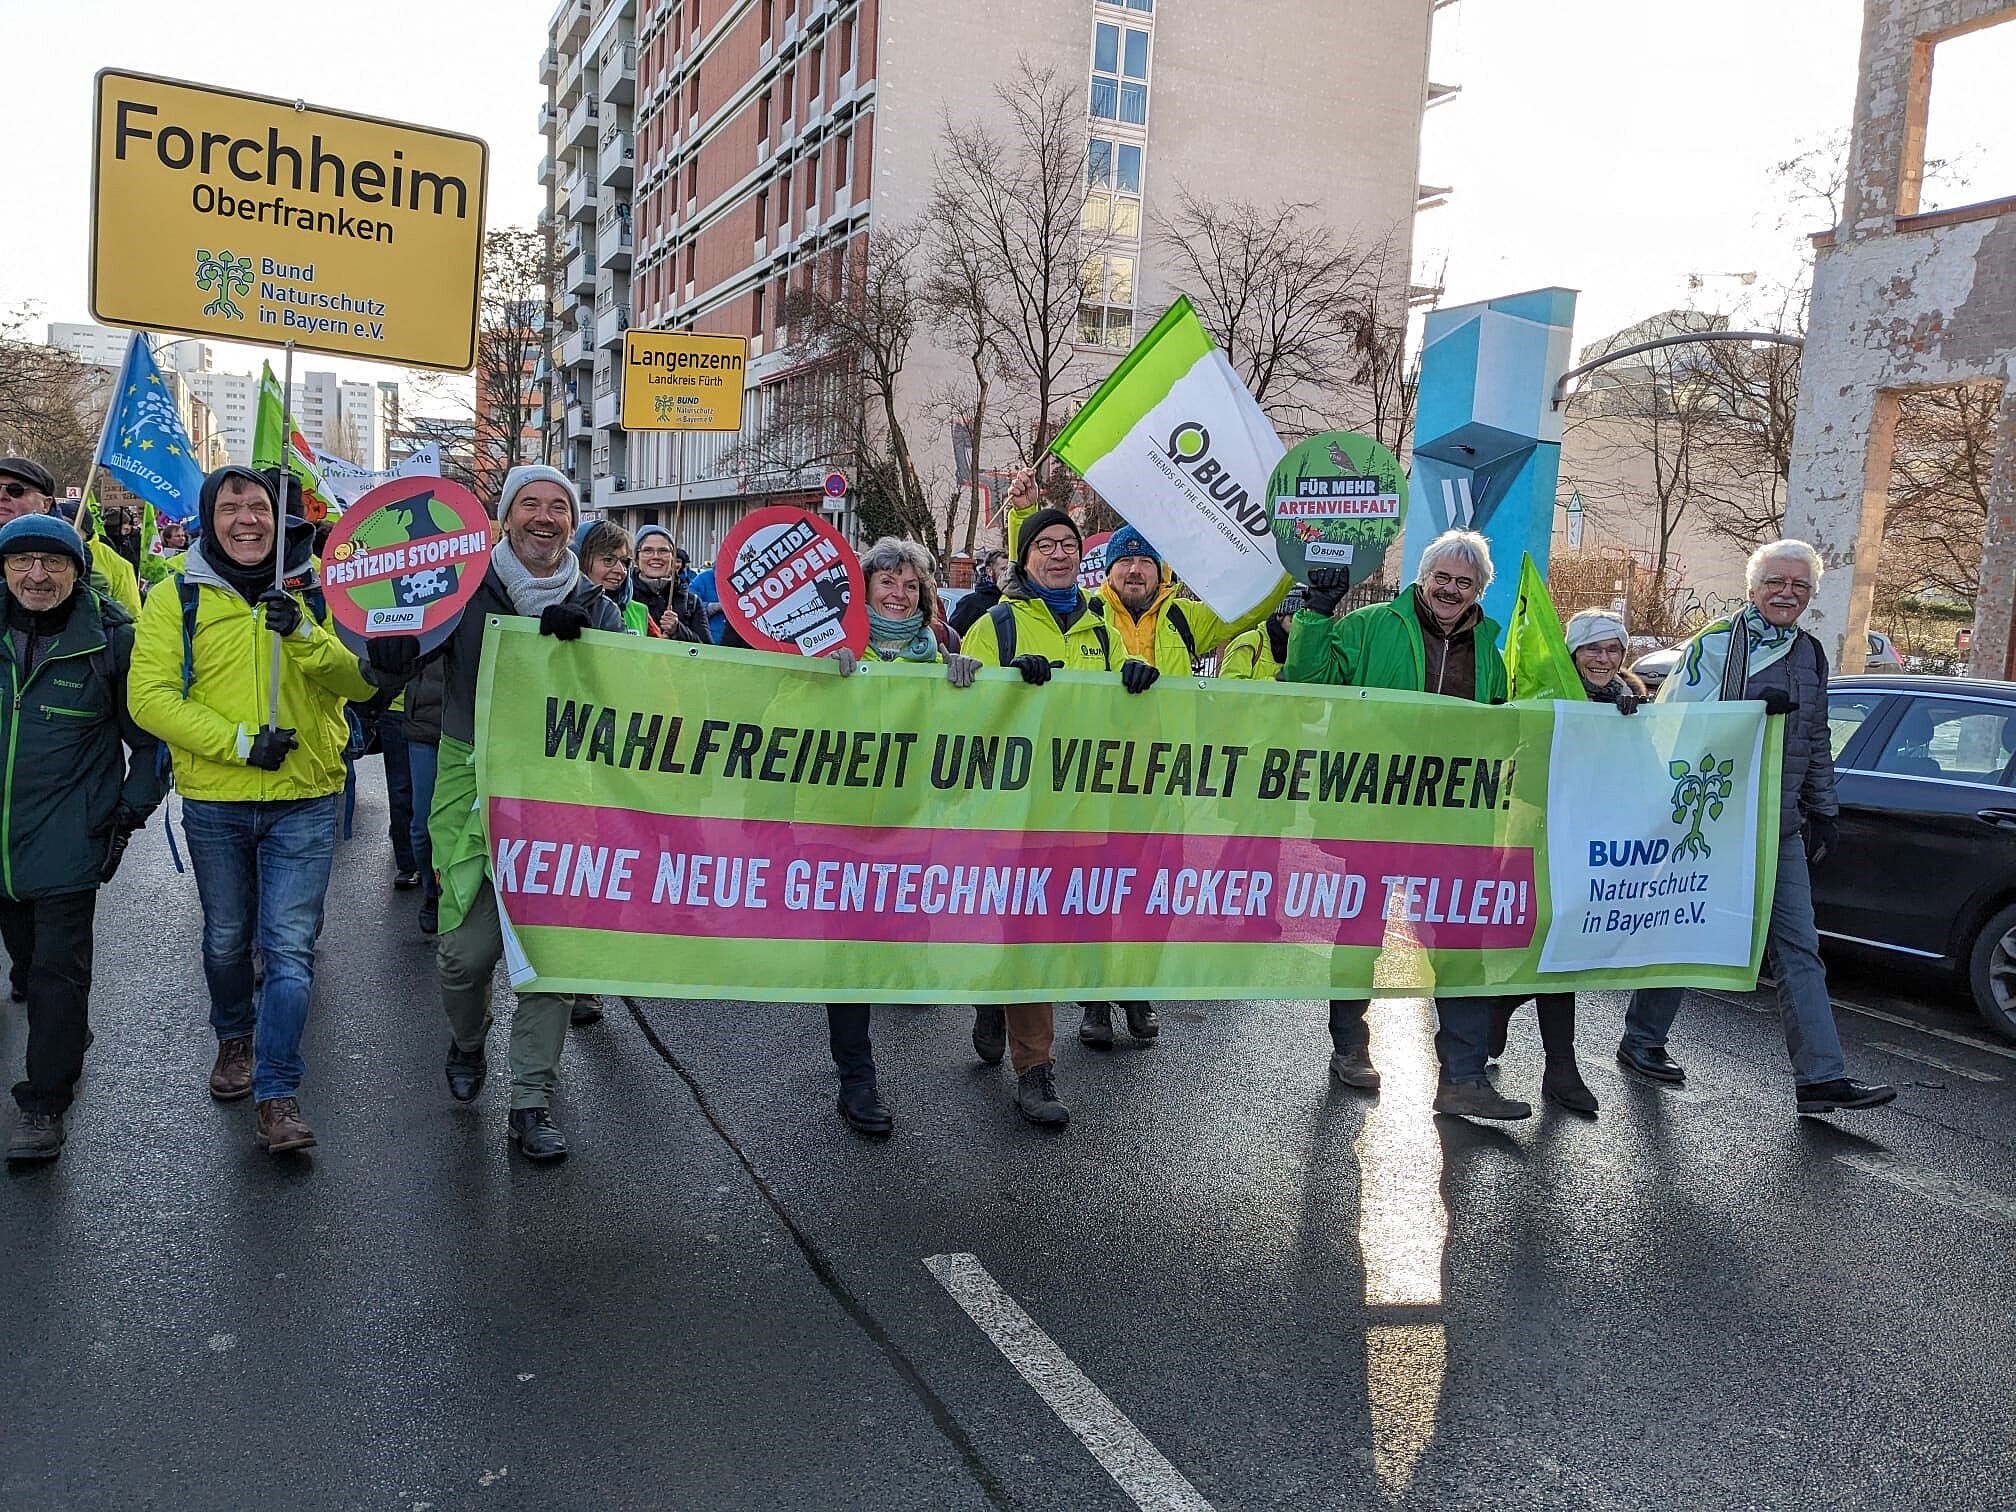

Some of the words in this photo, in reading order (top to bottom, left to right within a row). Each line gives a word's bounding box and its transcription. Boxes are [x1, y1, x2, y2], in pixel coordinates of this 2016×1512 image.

[115, 99, 467, 218] Forchheim
[192, 184, 393, 243] Oberfranken
[262, 258, 313, 281] Bund
[261, 283, 385, 316] Naturschutz
[260, 305, 276, 323] in
[284, 310, 347, 334] Bayern
[354, 322, 384, 339] e.V.
[630, 344, 741, 372] Langenzenn
[649, 373, 695, 386] Landkreis
[699, 376, 722, 386] Fürth
[1192, 457, 1271, 536] BUND
[1300, 478, 1328, 495] FÜR
[1332, 480, 1376, 494] MEHR
[1148, 450, 1176, 480] FRIENDS
[1174, 478, 1185, 490] OF
[1184, 488, 1199, 504] THE
[1196, 501, 1219, 524] EARTH
[1216, 522, 1250, 556] GERMANY
[1277, 500, 1397, 515] ARTENVIELFALT
[326, 549, 405, 586] PESTIZIDE
[408, 531, 487, 567] STOPPEN!
[731, 522, 814, 593] PESTIZIDE
[1080, 556, 1106, 573] PEST
[1320, 548, 1345, 557] BUND
[738, 538, 839, 618] STOPPEN
[1077, 571, 1107, 587] STO
[385, 613, 414, 623] BUND
[813, 628, 835, 644] BUND
[544, 697, 918, 788] WAHLFREIHEIT
[930, 734, 1033, 792] UND
[1051, 737, 1249, 798] VIELFALT
[1257, 748, 1516, 811] BEWAHREN!
[1589, 838, 1670, 867] BUND
[497, 838, 641, 902] KEINE
[651, 852, 770, 908] NEUE
[785, 860, 1053, 916] GENTECHNIK
[1061, 867, 1137, 917] AUF
[1145, 868, 1273, 917] ACKER
[1284, 873, 1367, 920] UND
[1380, 876, 1529, 925] TELLER!
[1589, 871, 1709, 902] Naturschutz
[1582, 911, 1602, 934] in
[1605, 908, 1670, 936] Bayern
[1674, 901, 1706, 925] e.V.
